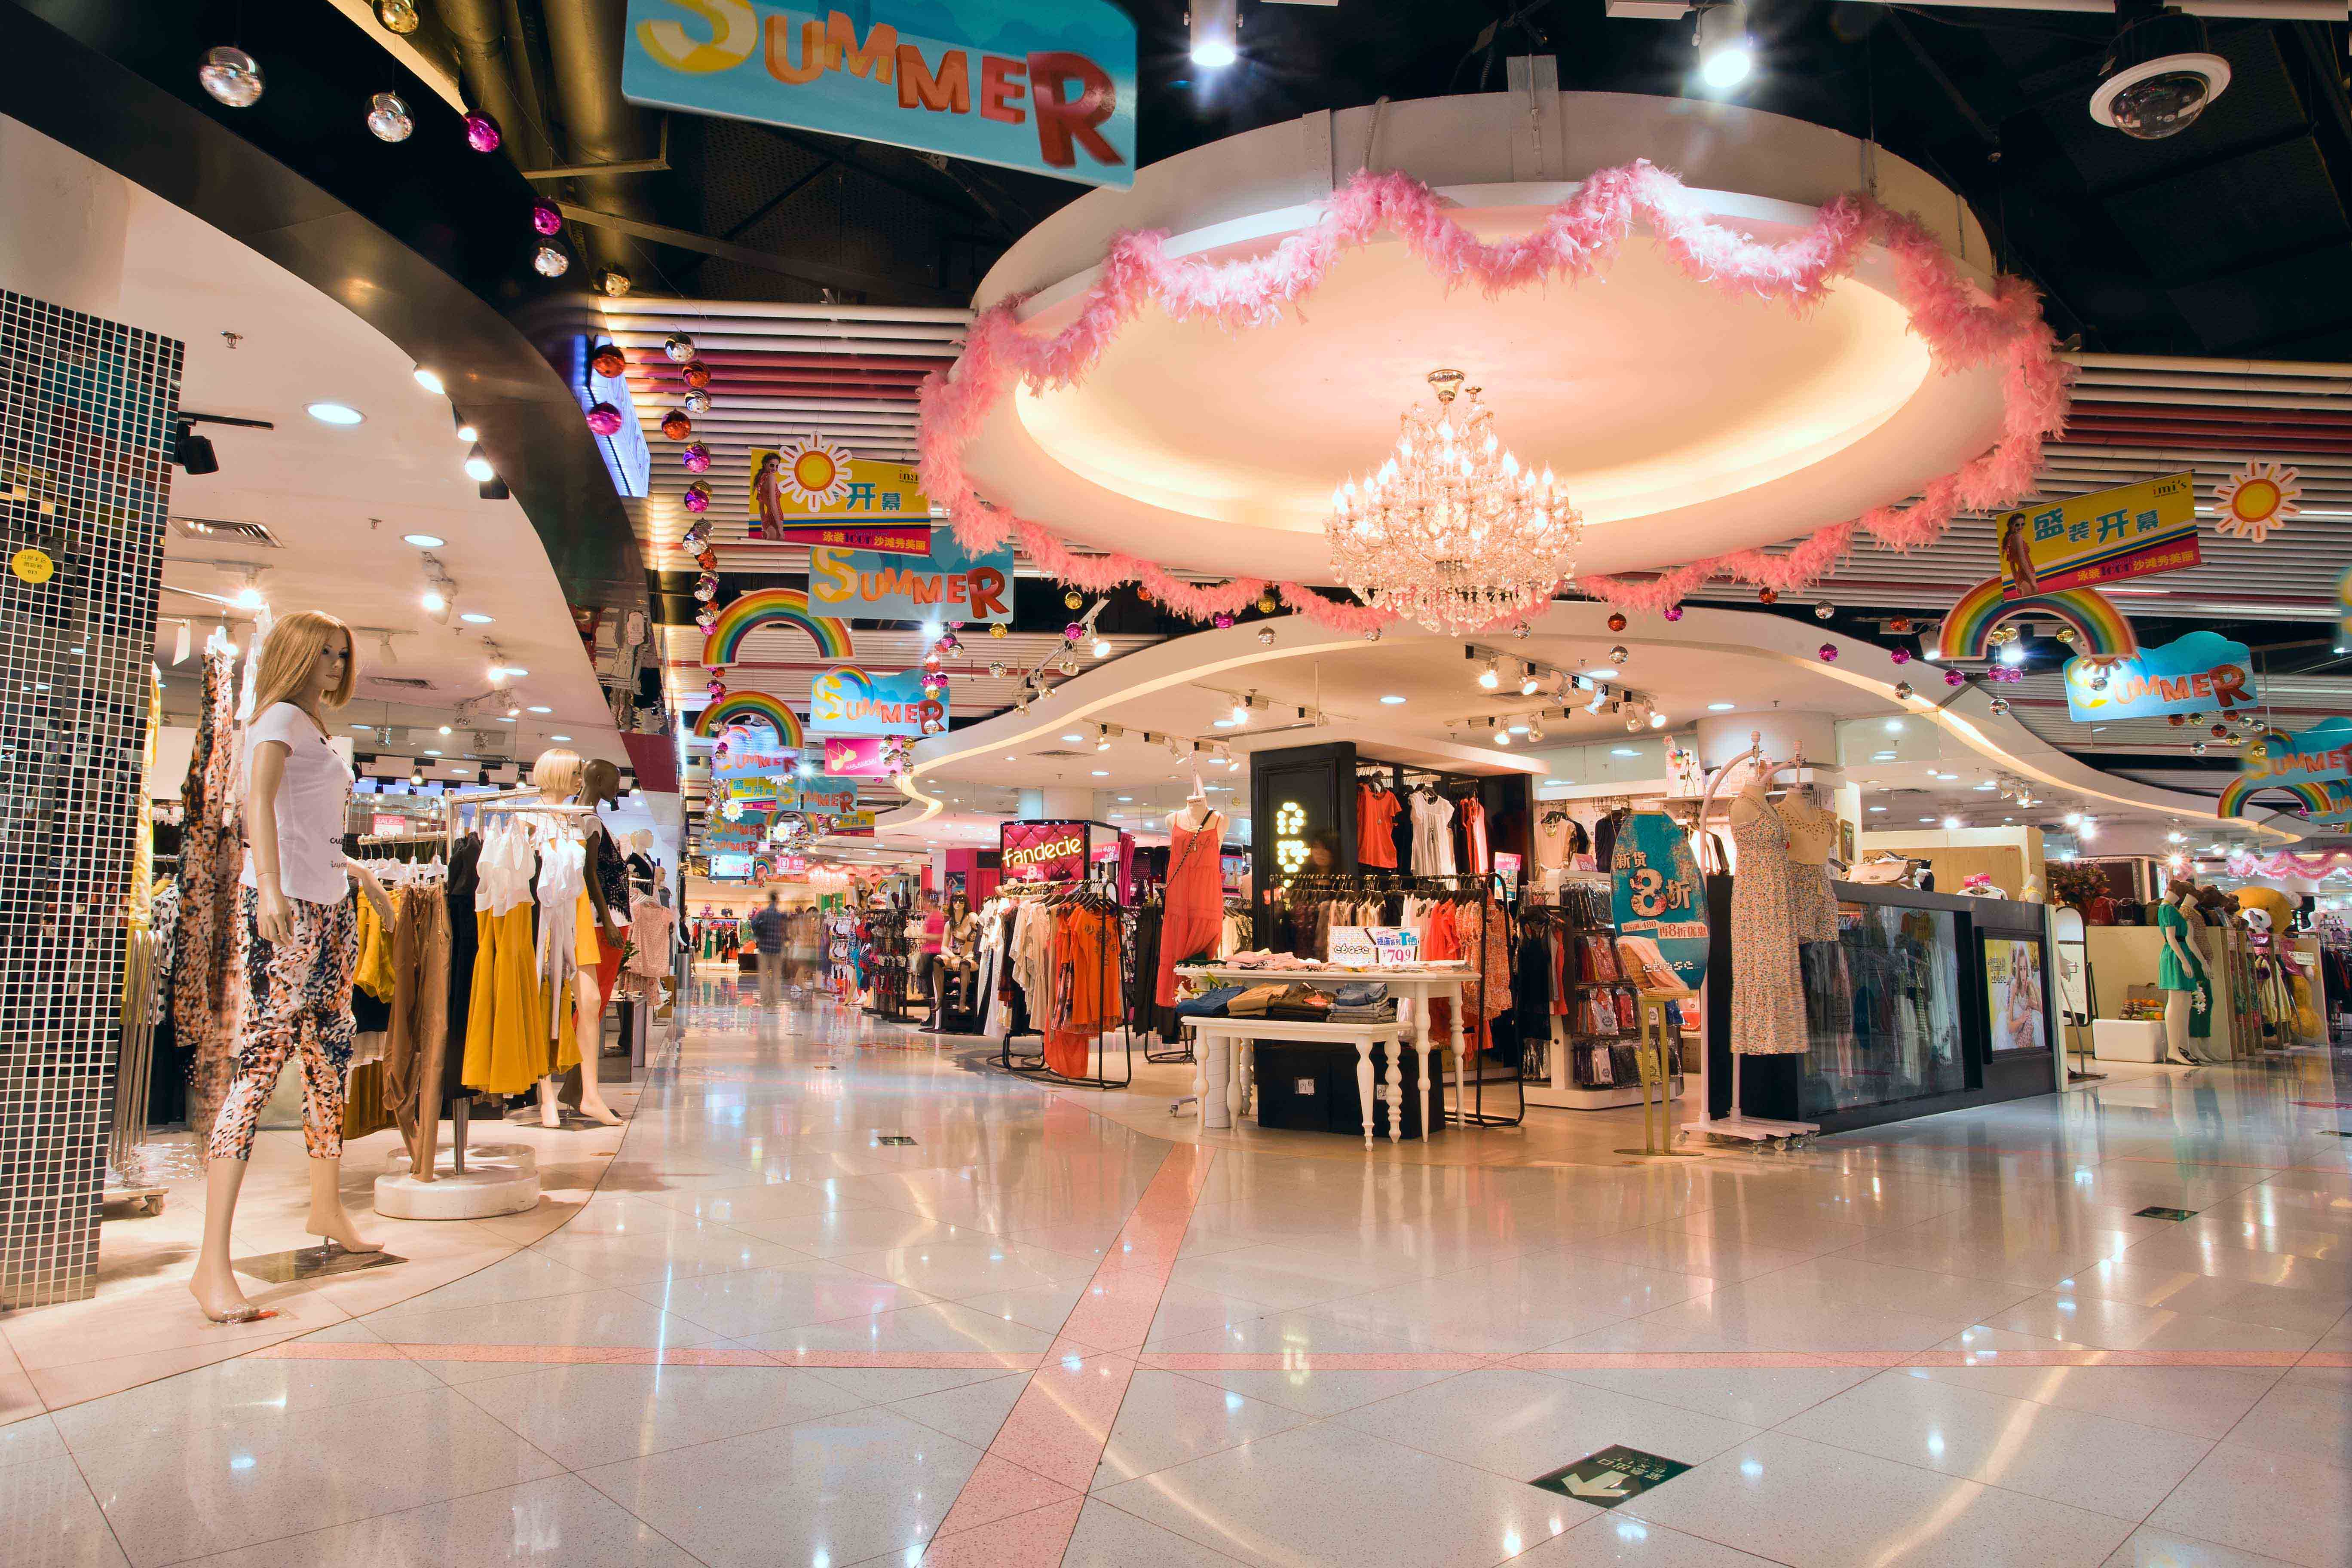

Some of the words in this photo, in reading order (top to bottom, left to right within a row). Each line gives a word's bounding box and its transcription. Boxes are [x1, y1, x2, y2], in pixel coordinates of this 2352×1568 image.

[636, 0, 1126, 168] SUMMER
[833, 482, 901, 511] 开幕
[874, 536, 926, 551] 沙滩秀美丽
[2033, 507, 2159, 545] 盛装开幕
[812, 548, 1010, 619] SUMMER
[813, 675, 944, 734] SUMMER
[778, 778, 855, 813] SMMER
[1002, 836, 1082, 867] fandecie
[1615, 851, 1647, 870] 新货
[1629, 868, 1692, 917] 8折
